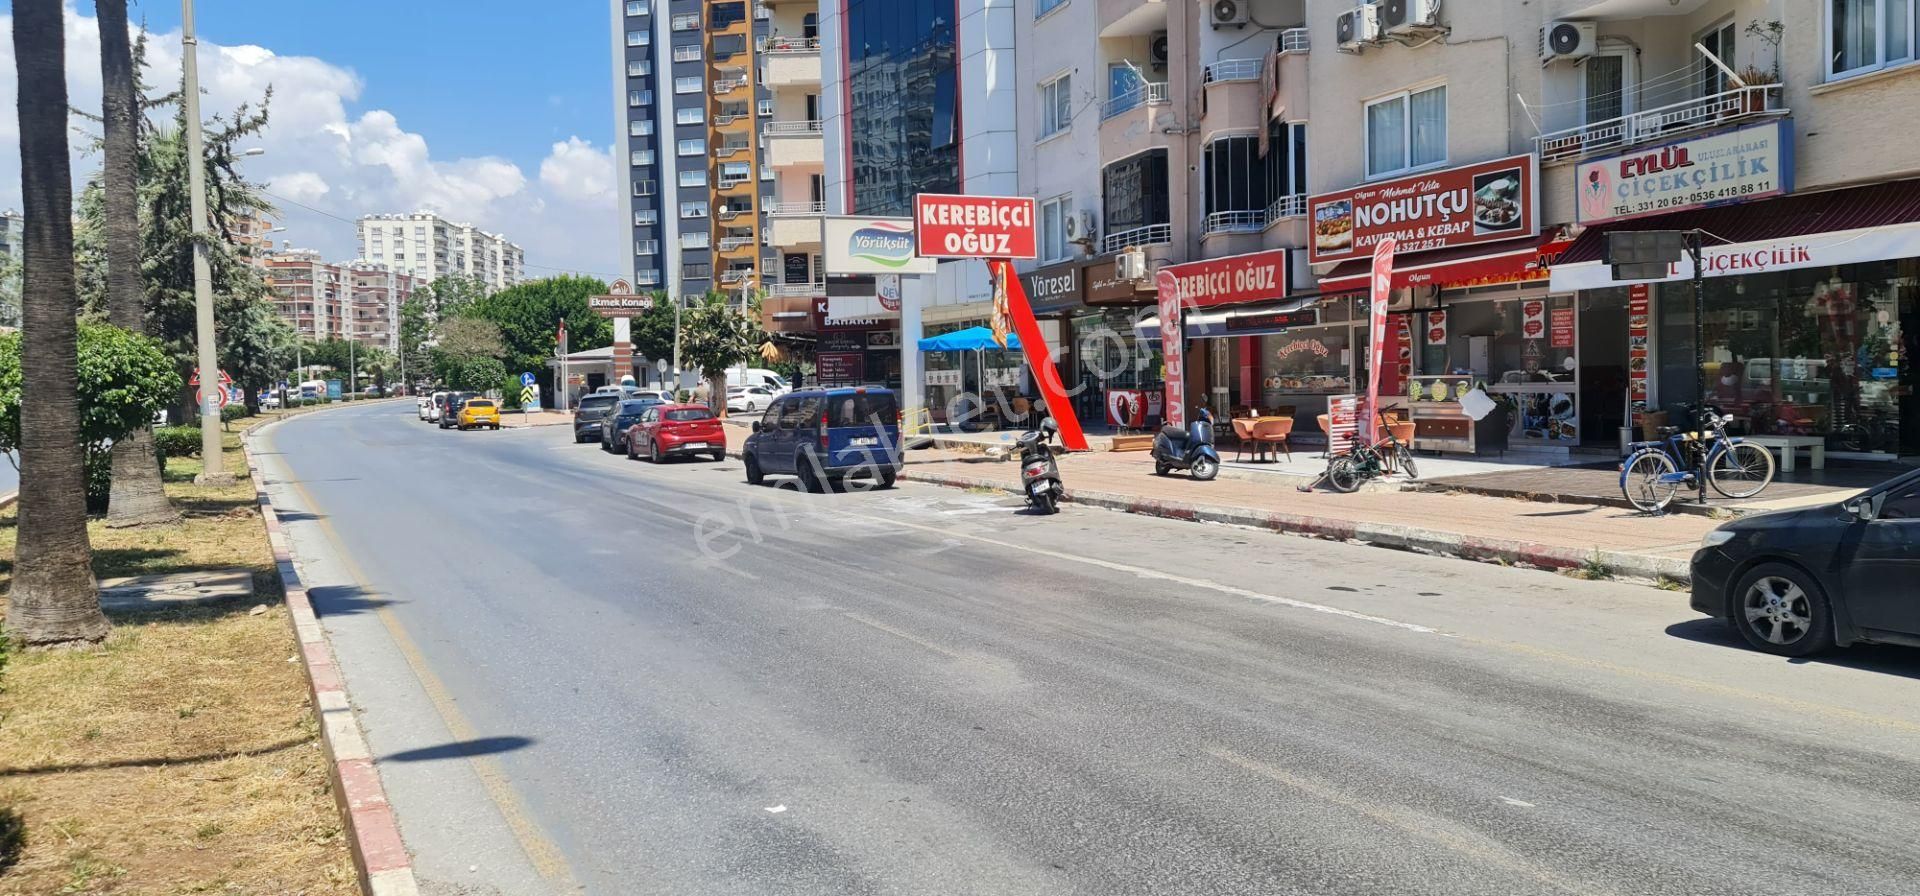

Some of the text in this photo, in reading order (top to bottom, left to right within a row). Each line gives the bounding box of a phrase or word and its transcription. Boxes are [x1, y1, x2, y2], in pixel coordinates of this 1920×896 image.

[1620, 139, 1768, 179] EYLÜL ULUSLARARASI
[1354, 180, 1440, 200] Olgun Mehmet Usta
[1617, 156, 1769, 202] ÇİÇEKÇİLİK
[1355, 188, 1468, 228] NOHUTÇU
[1614, 205, 1635, 215] TEL:
[1638, 201, 1654, 211] 331
[1658, 199, 1669, 208] 20
[1718, 186, 1737, 197] 418
[1740, 184, 1753, 194] 88
[1758, 181, 1770, 191] 11
[922, 201, 1030, 230] KEREBİÇCİ
[855, 235, 910, 250] Yörüksüt
[944, 227, 1011, 254] OĞUZ
[1355, 229, 1415, 248] KAVURMA
[1416, 227, 1425, 238] &
[1427, 221, 1470, 237] KEBAP
[1403, 241, 1421, 251] 327
[1421, 239, 1434, 249] 25
[1701, 243, 1811, 276] ÇİÇEKÇİLİK
[1031, 268, 1075, 297] Yöresel
[1177, 264, 1231, 300] REBİÇCİ
[1235, 261, 1276, 293] OĞUZ
[1408, 273, 1431, 283] Olgun
[591, 297, 651, 309] Ekmek Konağı
